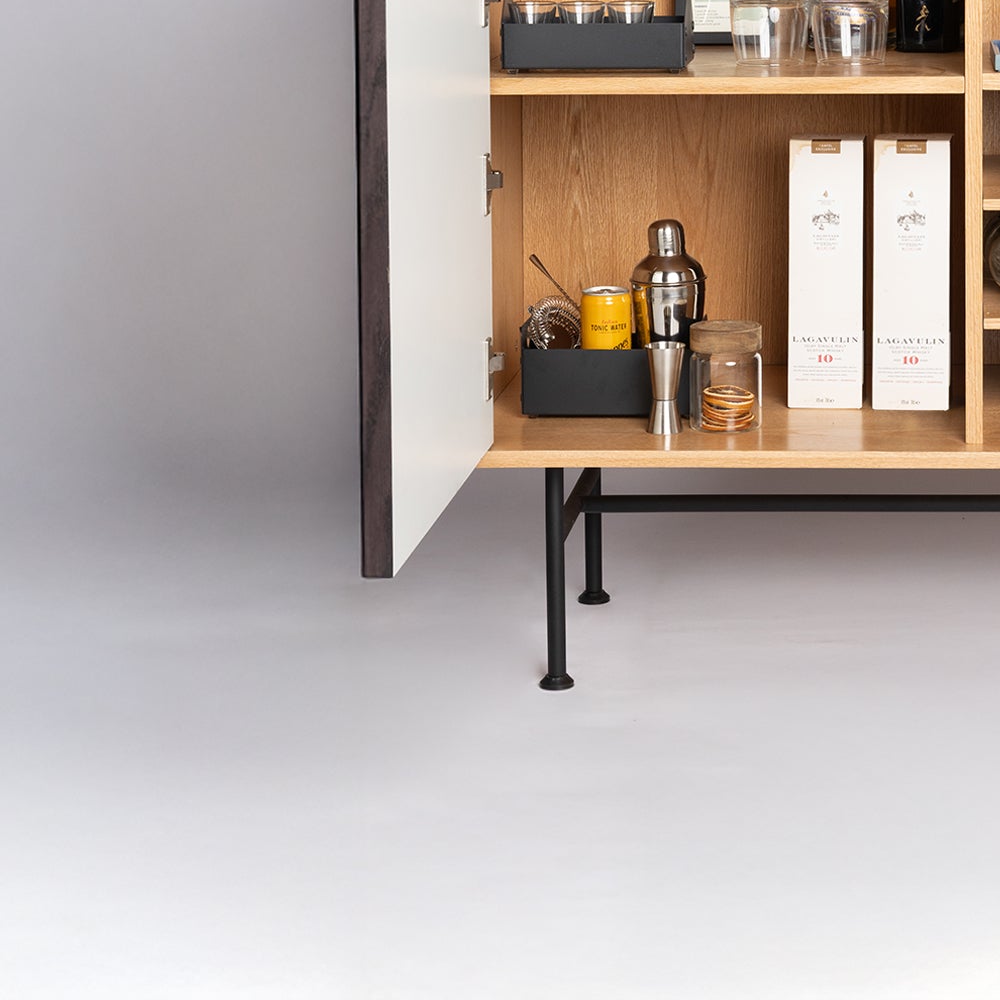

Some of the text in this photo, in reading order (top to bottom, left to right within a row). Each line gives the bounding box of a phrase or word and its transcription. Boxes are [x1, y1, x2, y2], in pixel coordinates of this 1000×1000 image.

[611, 323, 627, 331] WATER
[877, 337, 945, 345] LAGAVULIN
[817, 354, 833, 363] 10
[902, 355, 919, 365] 10
